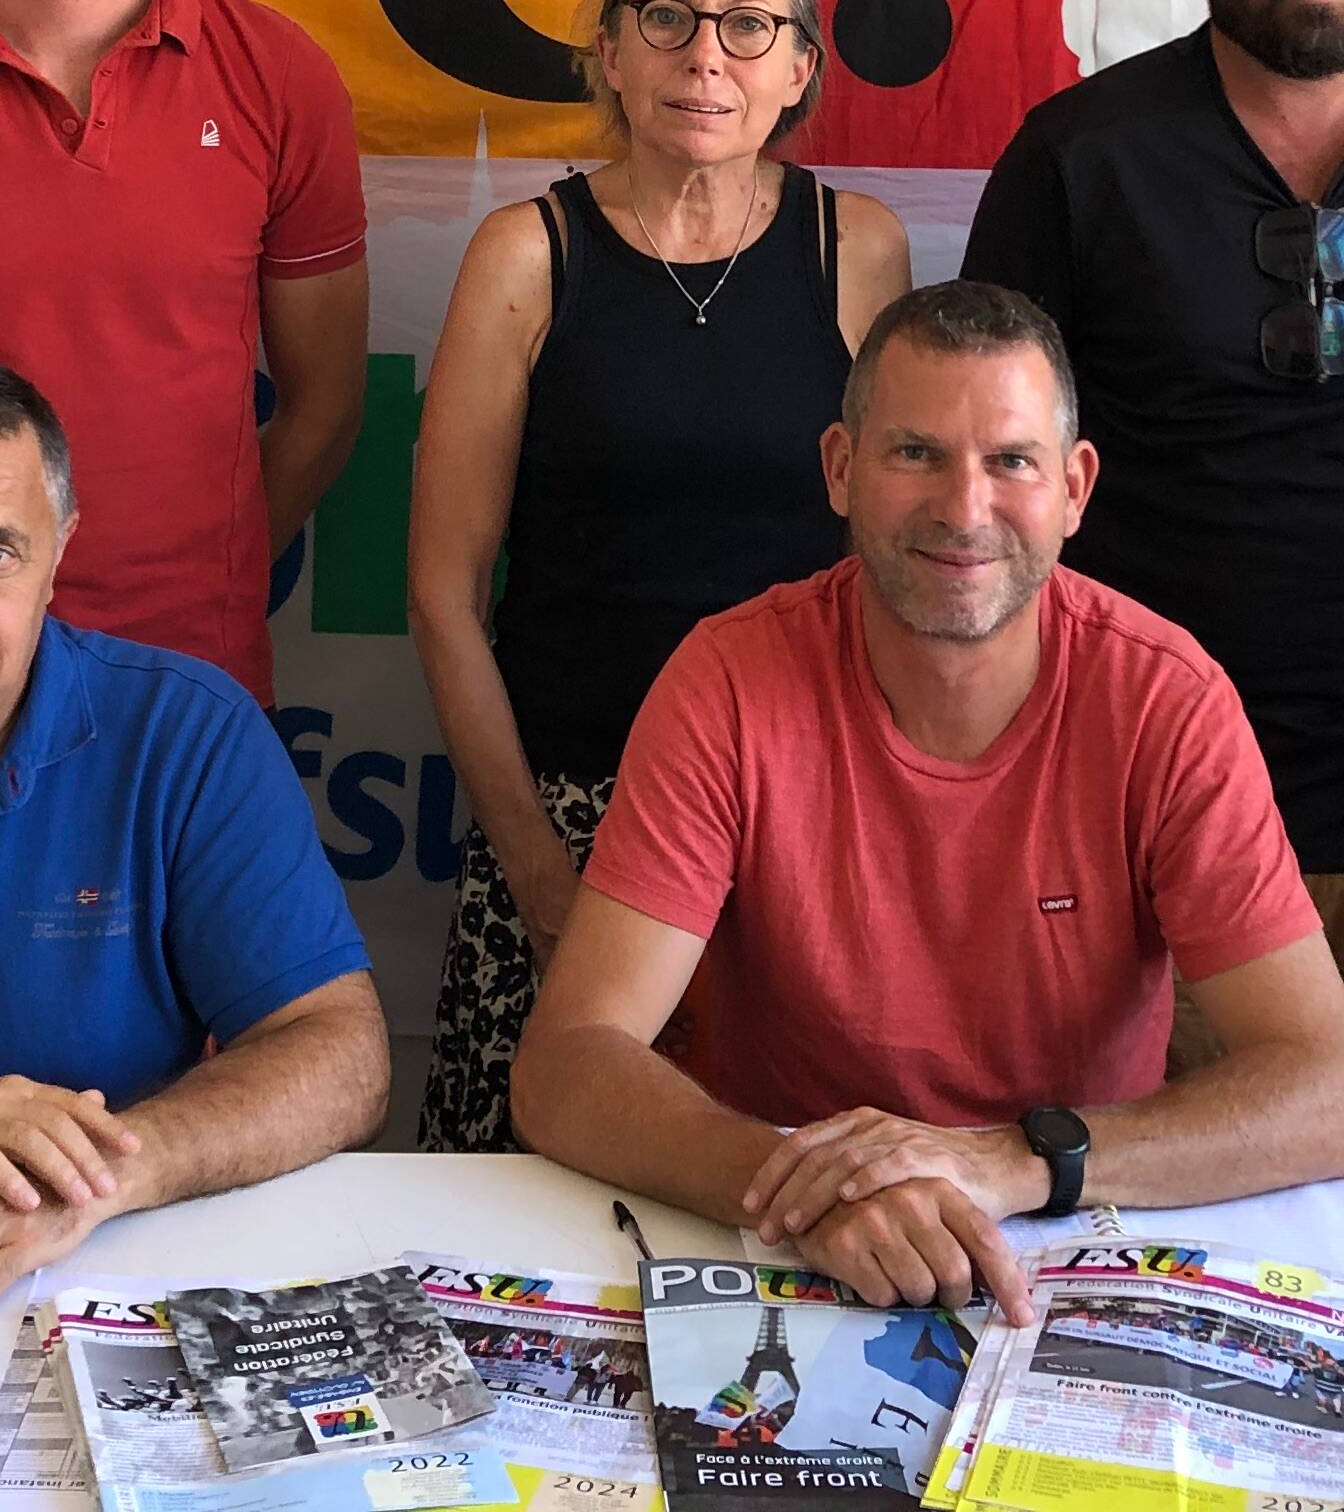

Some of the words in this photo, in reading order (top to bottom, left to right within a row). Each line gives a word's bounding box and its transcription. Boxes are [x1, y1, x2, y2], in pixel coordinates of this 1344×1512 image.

[1265, 1269, 1302, 1295] 83
[251, 1315, 337, 1333] Unitaire
[235, 1330, 345, 1354] Syndicale
[234, 1345, 353, 1372] Fédération
[507, 1394, 569, 1412] fonction
[572, 1407, 639, 1421] publique
[1056, 1378, 1095, 1392] Faire
[1100, 1382, 1137, 1397] front
[1142, 1390, 1192, 1408] contre
[1274, 1422, 1322, 1440] droite
[388, 1452, 473, 1473] 2022
[696, 1453, 735, 1465] Face
[755, 1454, 832, 1466] l'extrême
[836, 1455, 883, 1466] droite
[554, 1475, 639, 1500] 2024
[697, 1468, 784, 1487] Faire
[796, 1468, 883, 1488] front
